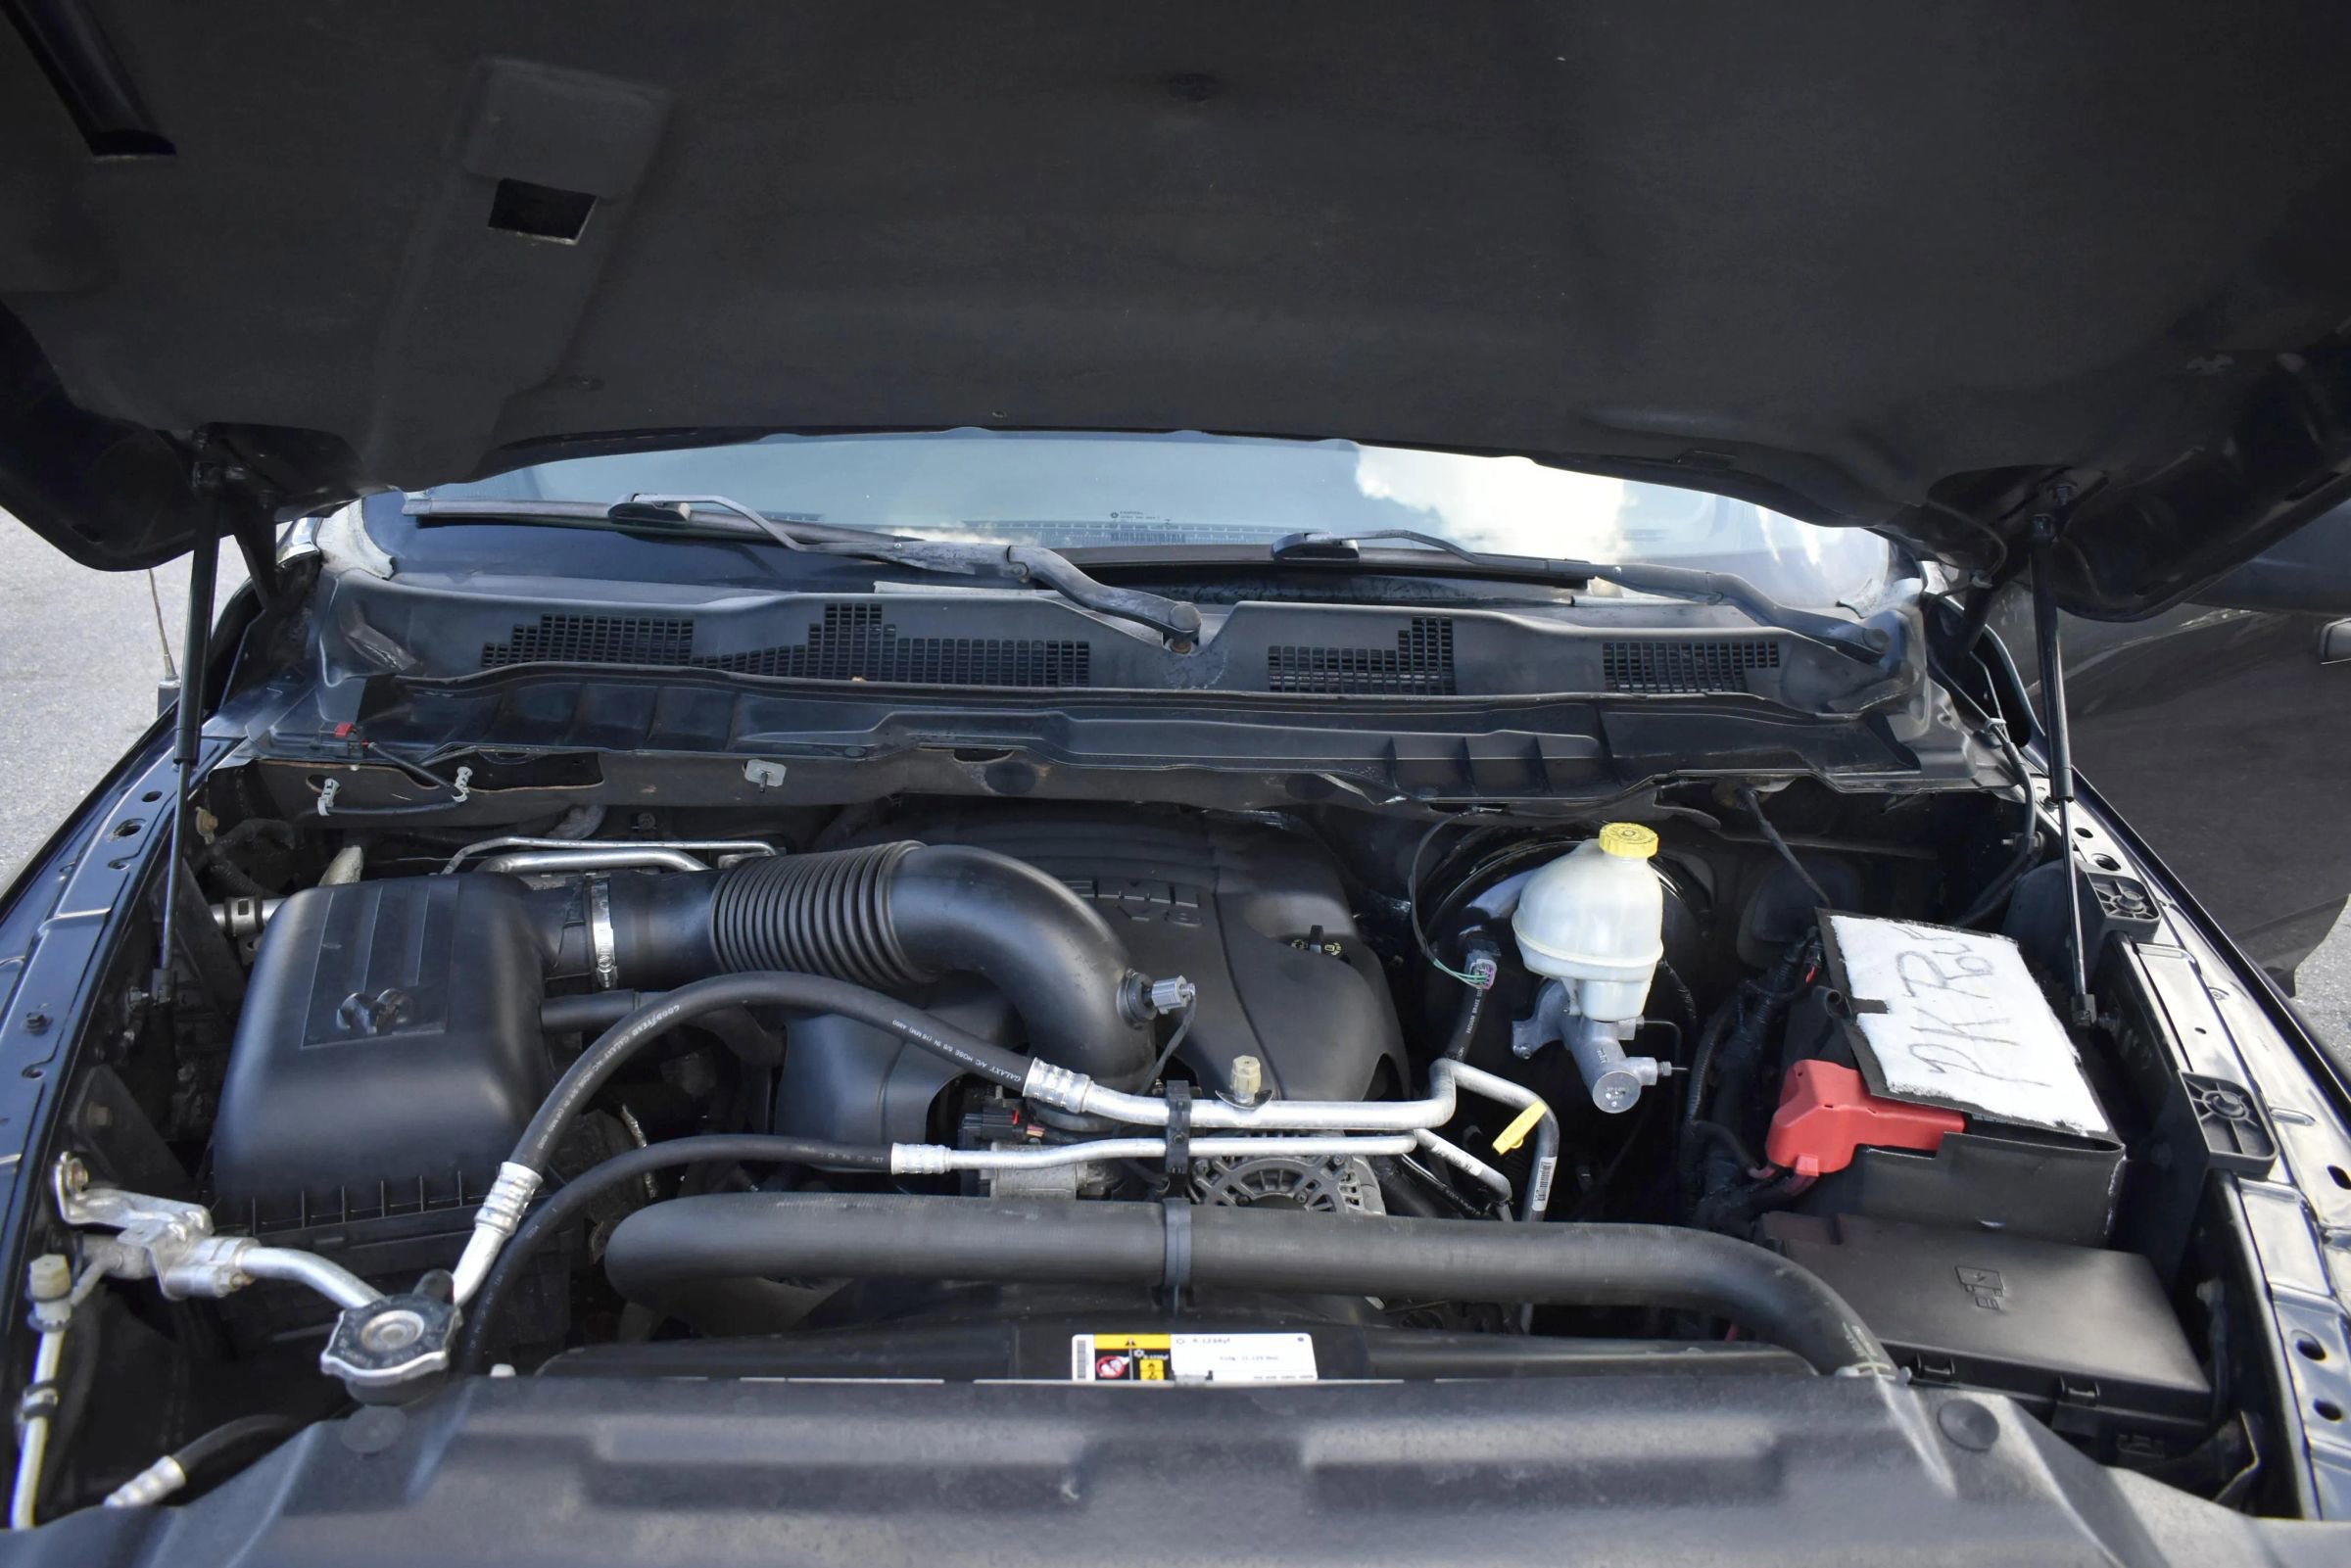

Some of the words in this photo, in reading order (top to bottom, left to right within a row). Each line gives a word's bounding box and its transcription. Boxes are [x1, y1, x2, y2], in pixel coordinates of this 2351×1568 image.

[603, 1035, 630, 1059] GALAXY
[955, 1049, 973, 1063] HOSE
[975, 1059, 987, 1068] A/C
[989, 1066, 1022, 1082] GALAXY
